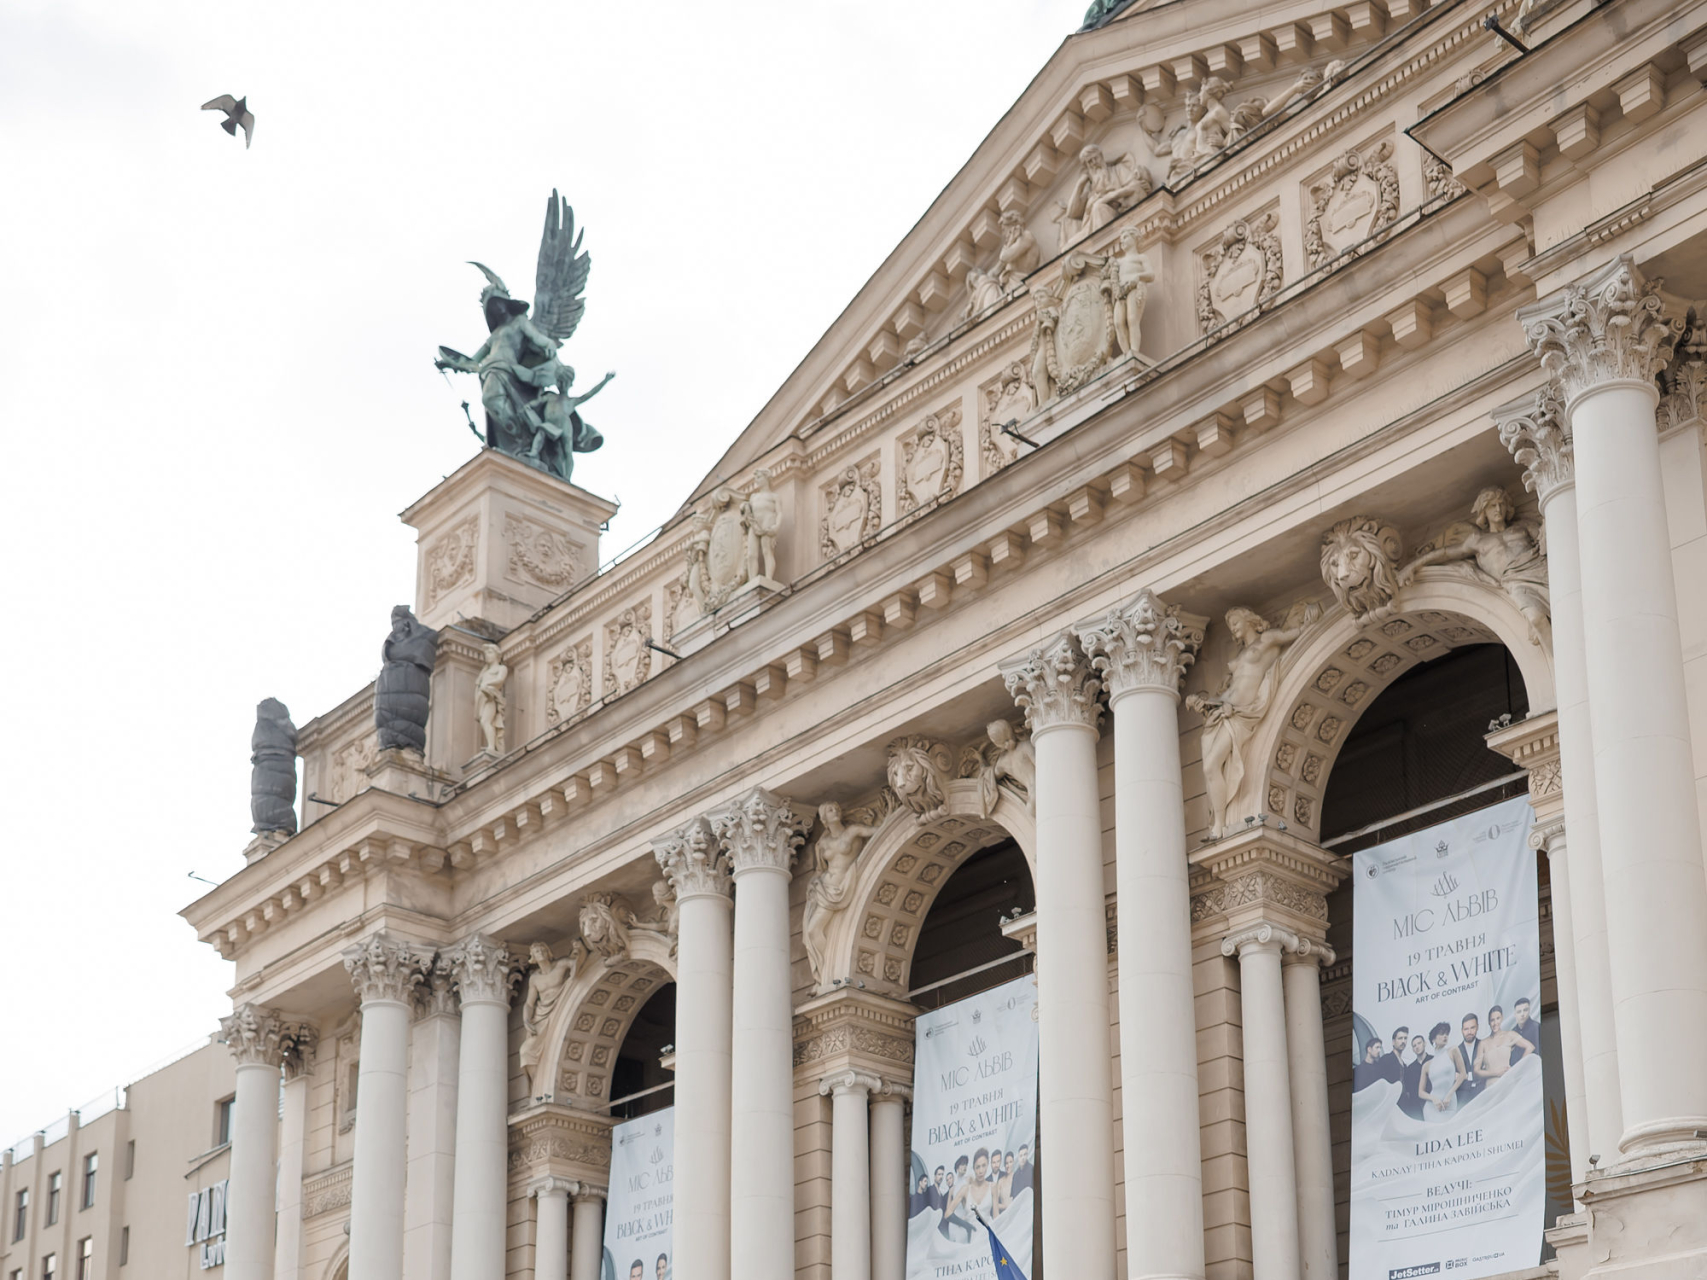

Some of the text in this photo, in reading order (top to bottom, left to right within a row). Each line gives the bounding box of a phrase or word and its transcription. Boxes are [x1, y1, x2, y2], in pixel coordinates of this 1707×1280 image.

[1394, 909, 1434, 940] МІС
[1408, 933, 1486, 966] 19 ТРАВНЯ
[1377, 944, 1517, 1003] BLACK & WHITE
[1416, 980, 1478, 1004] ART OF CONTRAST
[941, 1066, 969, 1092] МІС
[950, 1088, 1003, 1116] 19 ТРАВНЯ
[928, 1099, 1023, 1145] BLACK & WHITE
[954, 1139, 963, 1147] ART
[972, 1128, 997, 1142] CONTRAST
[1415, 1129, 1483, 1155] LIDA LEE
[1371, 1166, 1412, 1179] KADNAY
[1444, 1150, 1481, 1166] КАРОЛЬ
[1488, 1140, 1523, 1156] SHUMEI
[628, 1165, 673, 1193] МІС ЛЬВ
[1427, 1180, 1472, 1198] ВЕДУЧІ:
[633, 1204, 641, 1214] 19
[1385, 1186, 1512, 1219] ТІМУР МІРОШНИЧЕНКО
[1404, 1213, 1448, 1228] ГАЛИНА
[1451, 1199, 1511, 1219] ЗАВІЙСЬКА
[617, 1218, 644, 1239] BLACK
[646, 1219, 652, 1230] &
[935, 1256, 994, 1278] ТІНА КАРО
